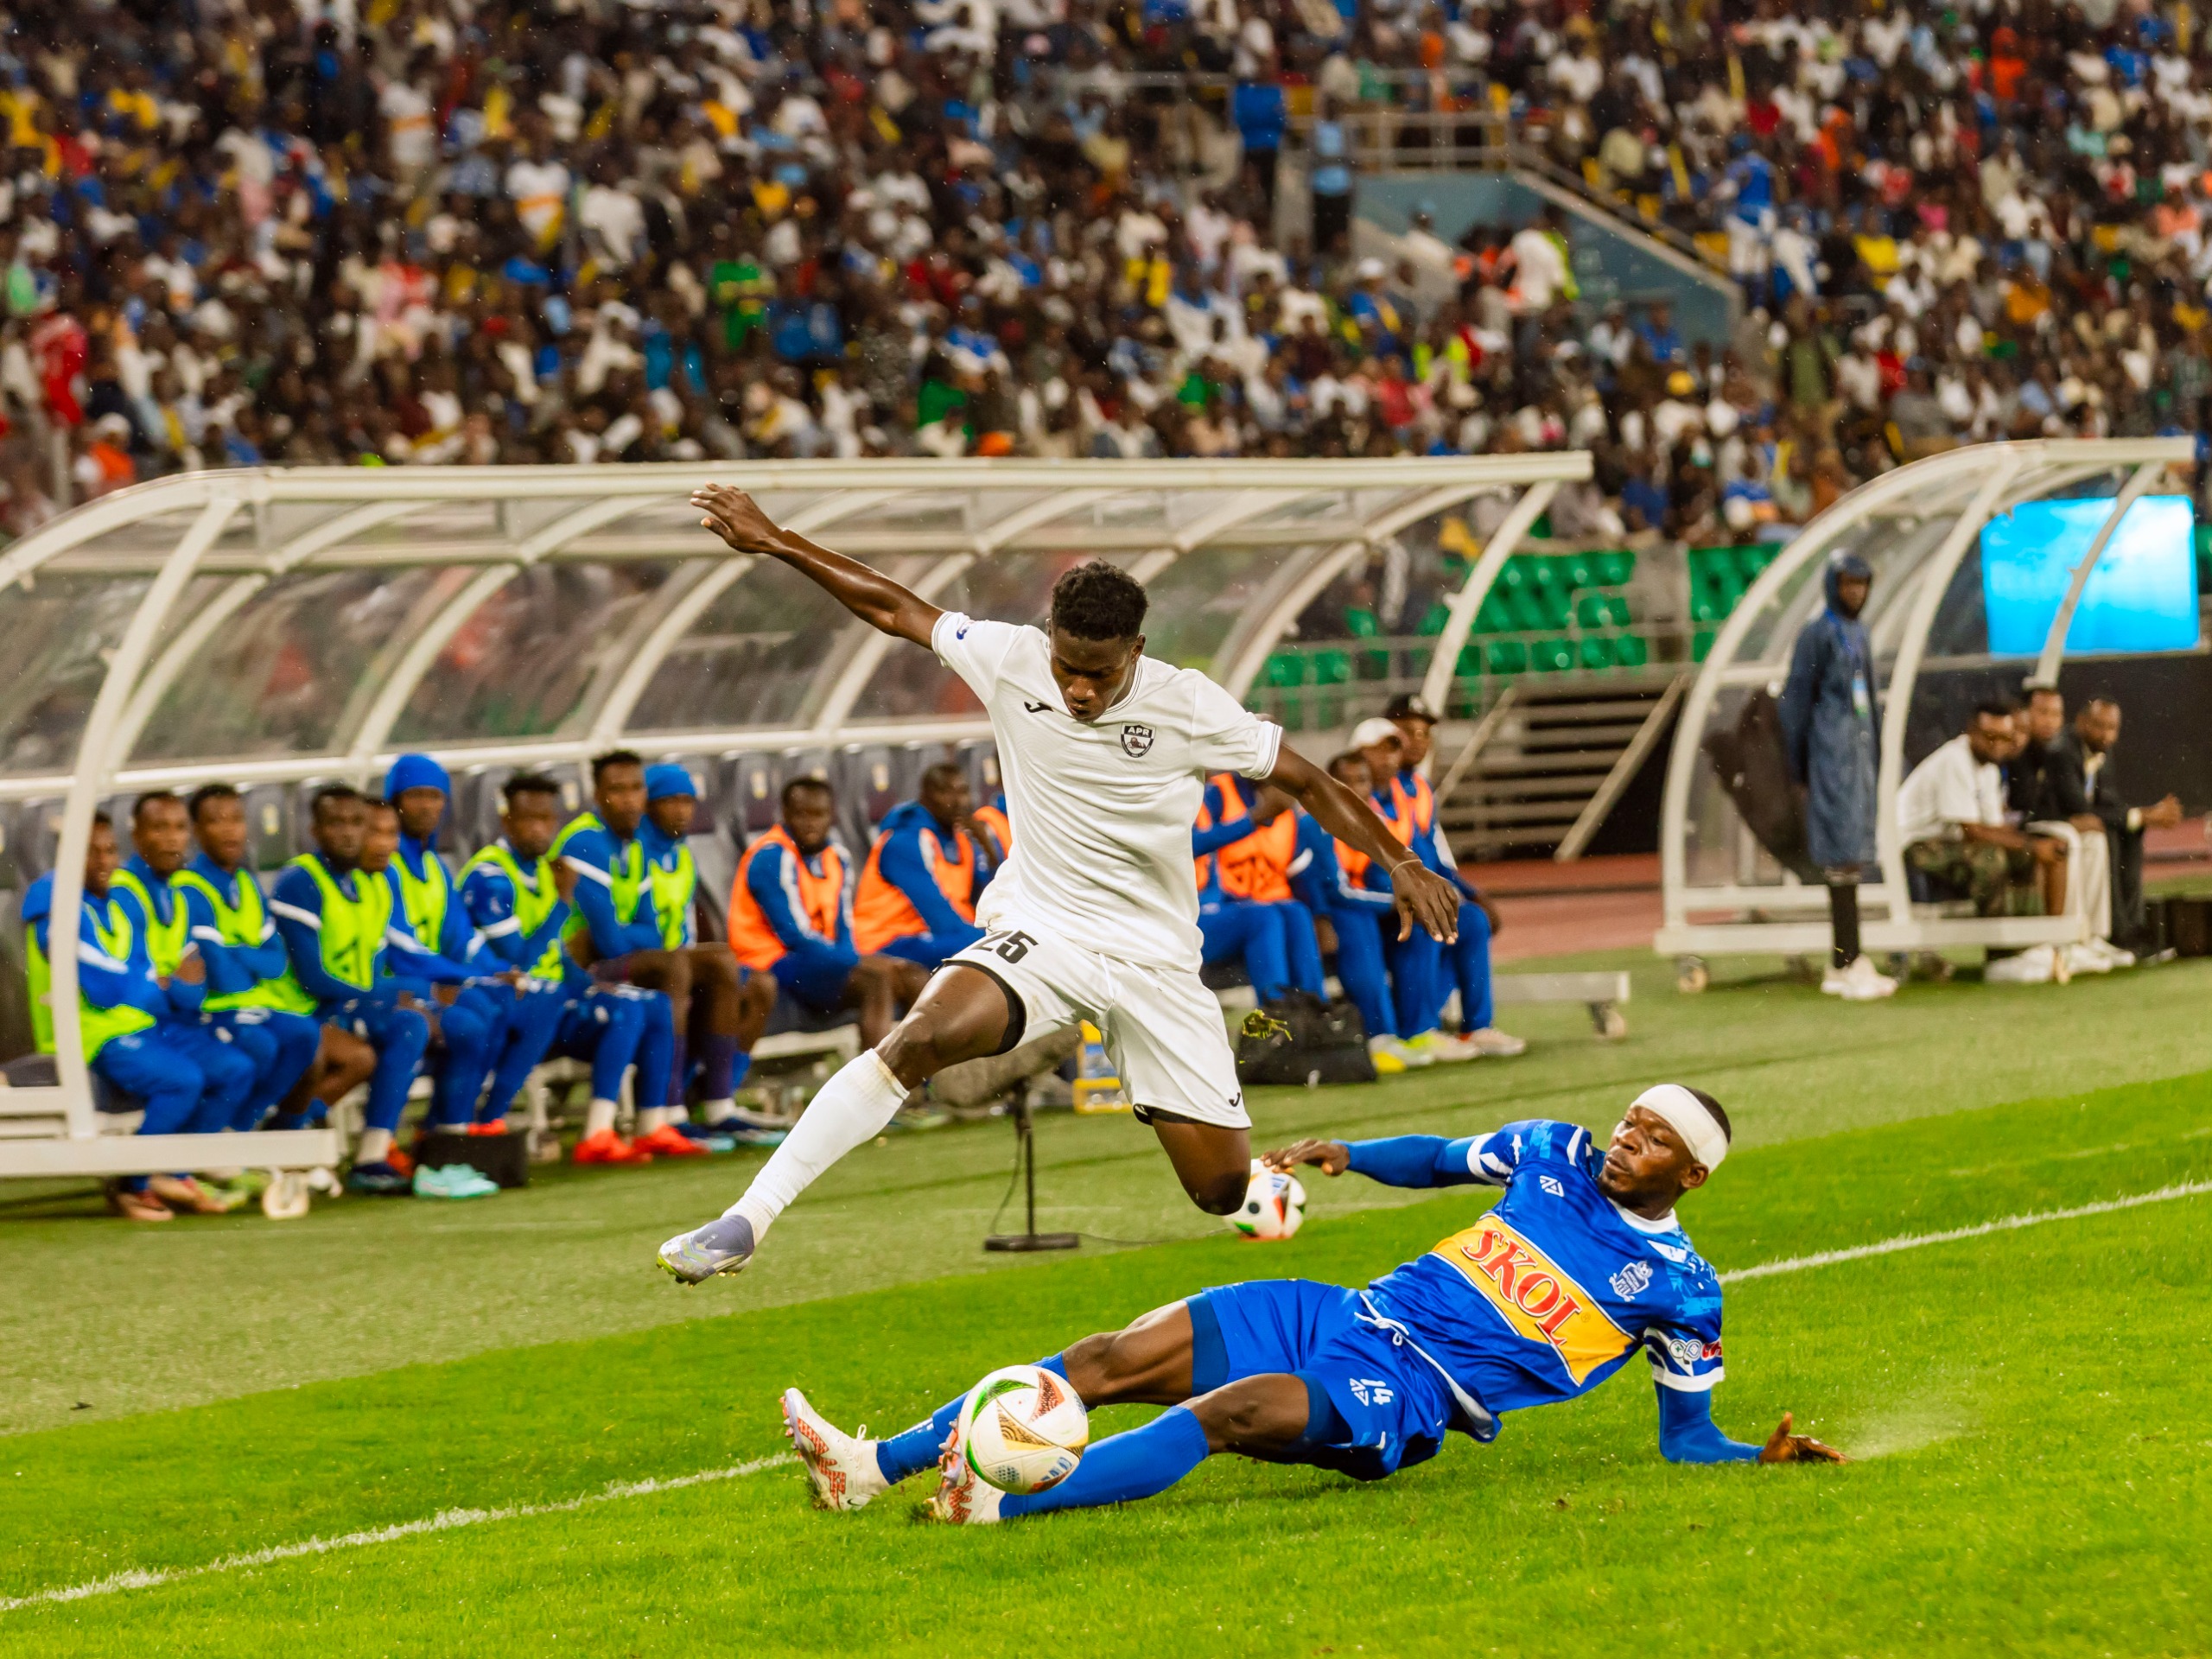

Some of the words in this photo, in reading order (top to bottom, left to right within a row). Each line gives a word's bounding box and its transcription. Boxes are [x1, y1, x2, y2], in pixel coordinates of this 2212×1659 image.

[1127, 726, 1150, 736] APR
[1460, 1229, 1583, 1347] SKOL
[1359, 1378, 1394, 1405] 14
